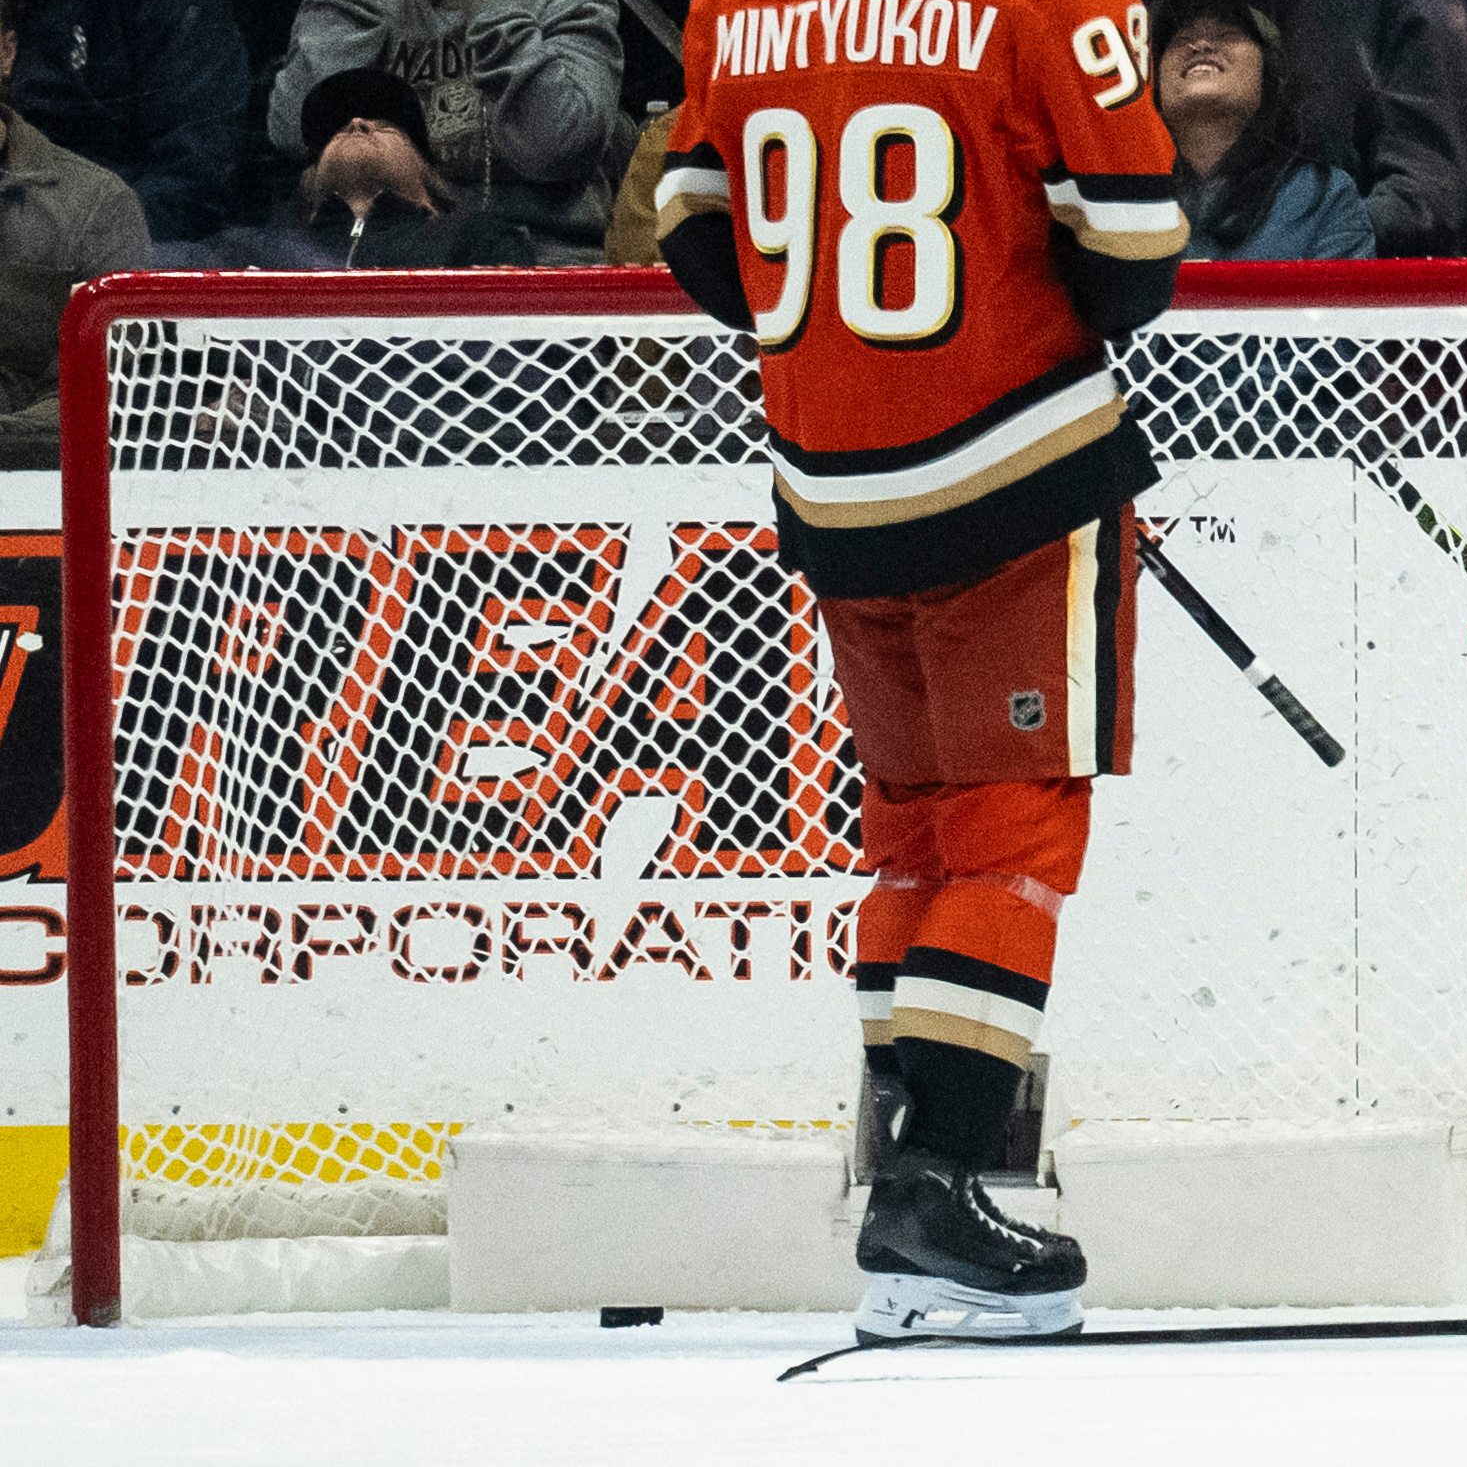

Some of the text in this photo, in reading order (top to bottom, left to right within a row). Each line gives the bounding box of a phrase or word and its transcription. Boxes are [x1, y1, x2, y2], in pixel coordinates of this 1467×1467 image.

[1071, 2, 1151, 110] 98
[746, 103, 957, 348] 98
[0, 901, 858, 985] CORPORATI
